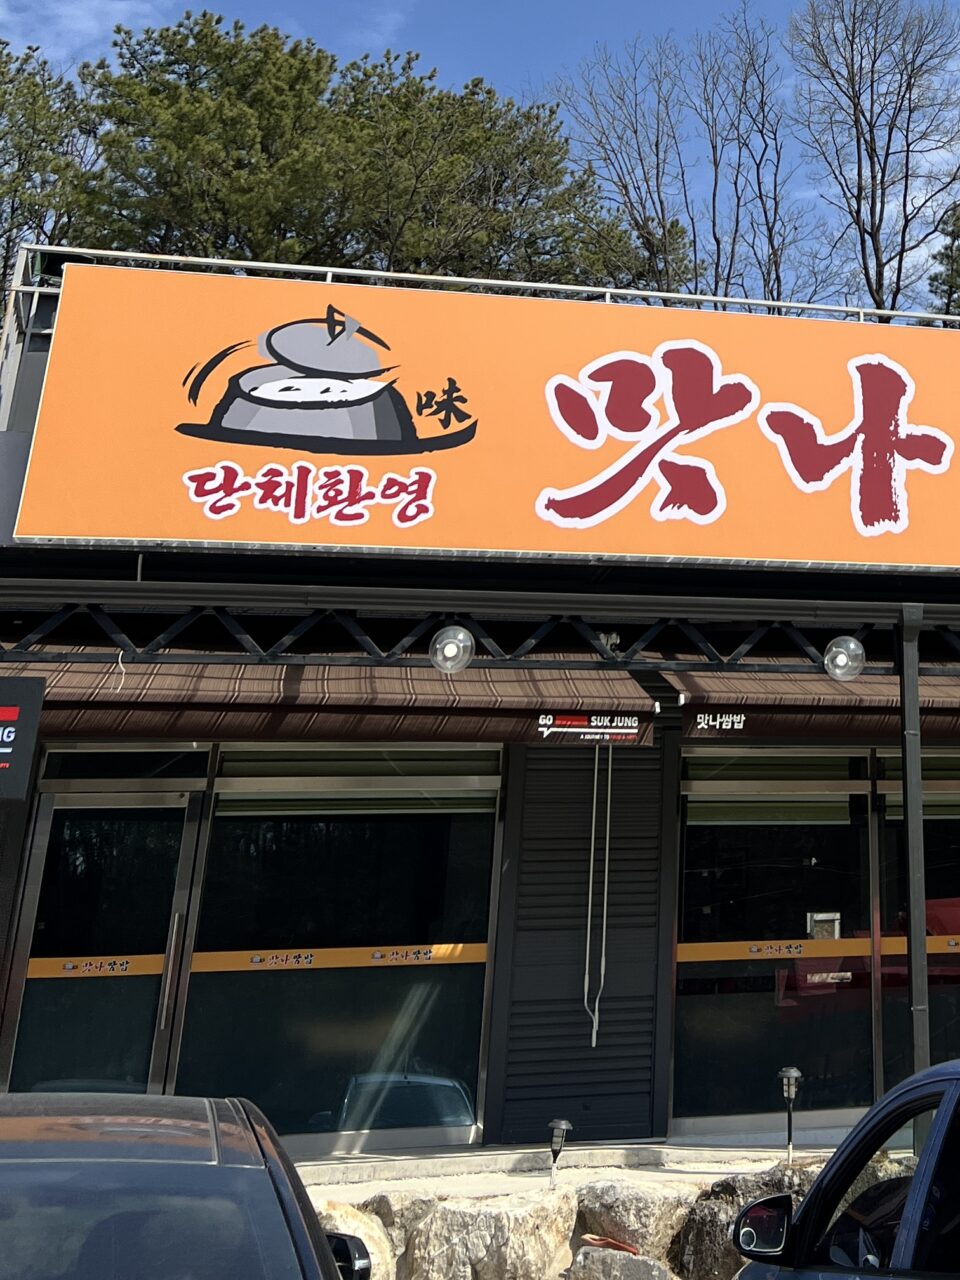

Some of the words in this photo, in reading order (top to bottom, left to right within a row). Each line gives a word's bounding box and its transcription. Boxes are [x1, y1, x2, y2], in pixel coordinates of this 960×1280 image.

[416, 378, 472, 429] 味
[187, 463, 434, 524] 단체환영
[538, 714, 553, 725] GO
[590, 716, 611, 726] SUK
[612, 716, 639, 727] JUNG
[697, 713, 745, 729] 맛나쌈밥
